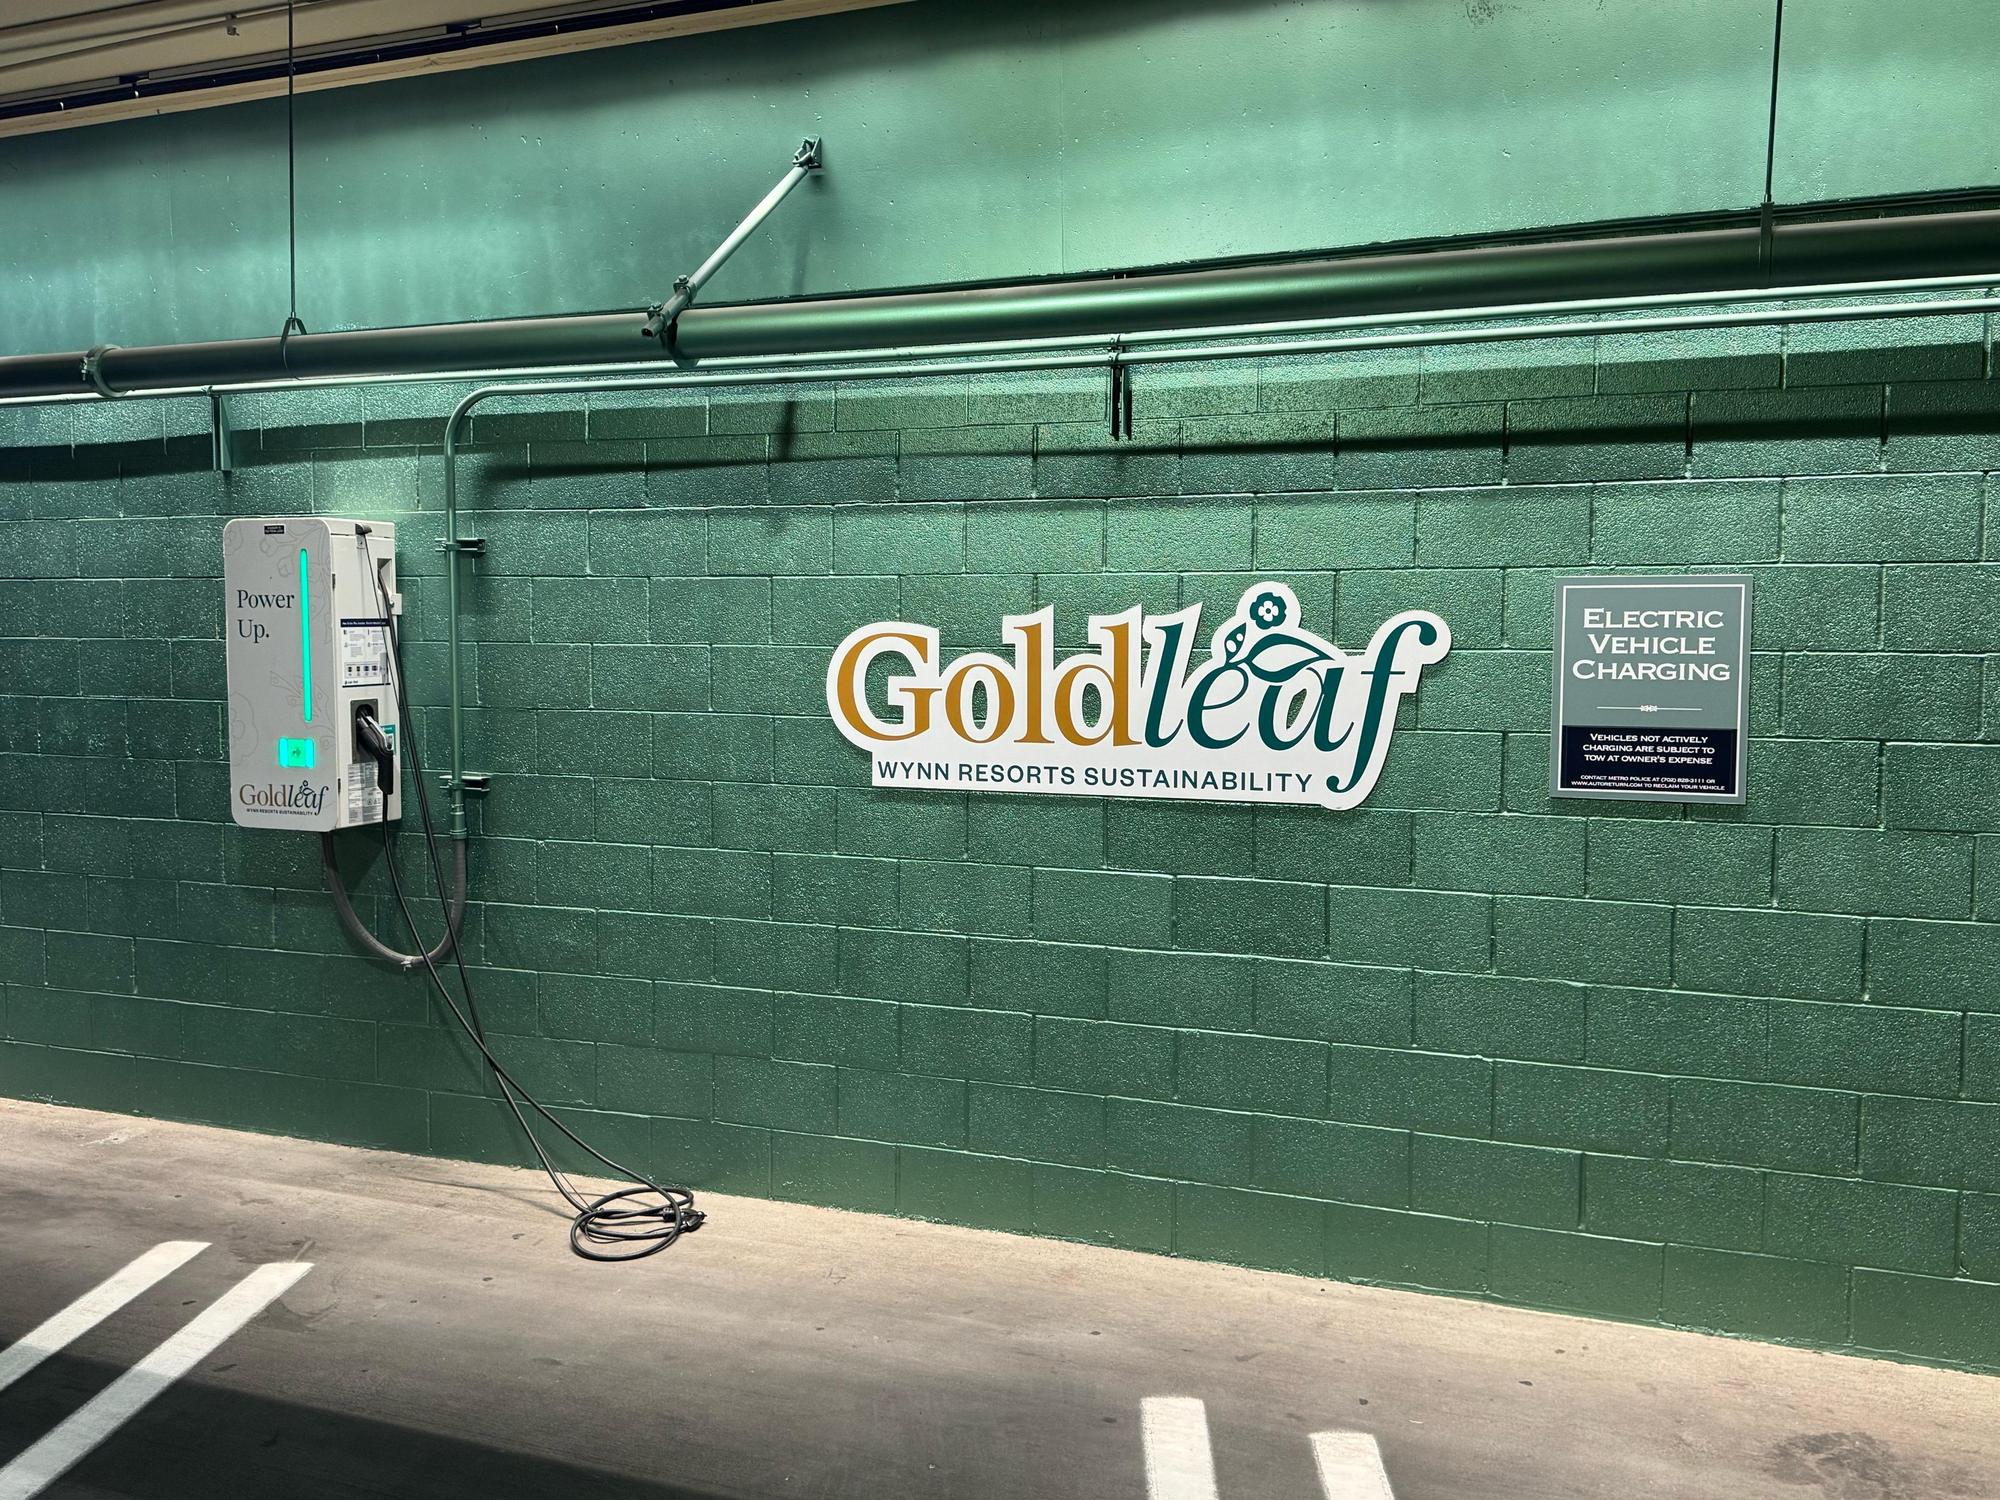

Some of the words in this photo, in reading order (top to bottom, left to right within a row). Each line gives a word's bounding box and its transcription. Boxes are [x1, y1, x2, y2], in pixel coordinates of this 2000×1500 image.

[236, 589, 295, 609] Power
[1583, 607, 1724, 629] ELECTRIC
[237, 619, 270, 644] Up.
[1587, 633, 1716, 655] VEHICLE
[1572, 659, 1731, 681] CHARGING
[836, 618, 1438, 793] Goldleaf
[1582, 744, 1633, 752] CHARGING
[1635, 745, 1654, 753] ARE
[1656, 745, 1700, 754] SUBJECT
[1590, 733, 1638, 742] VEHICLES
[1662, 735, 1708, 744] ACTIVELY
[1584, 754, 1605, 762] TOW
[1621, 755, 1666, 763] OWNER'S
[1668, 756, 1713, 765] EXPENSE
[877, 760, 950, 781] WYNN
[958, 762, 1076, 786] RESORTS
[1084, 767, 1313, 793] SUSTAINABILITY
[239, 783, 329, 816] Goldleaf
